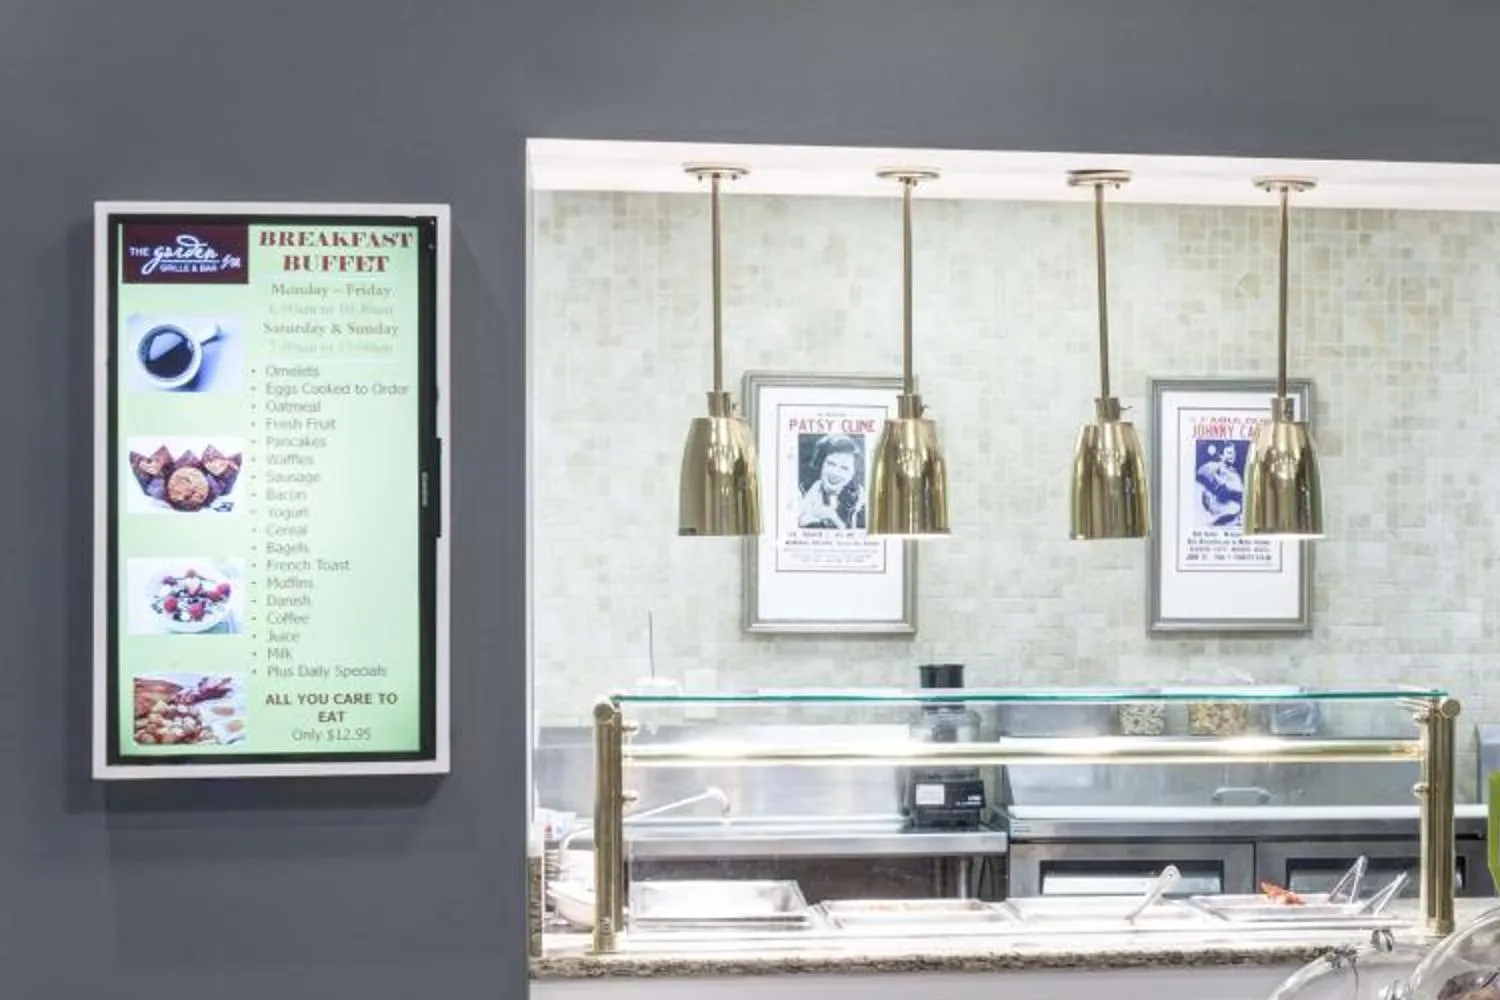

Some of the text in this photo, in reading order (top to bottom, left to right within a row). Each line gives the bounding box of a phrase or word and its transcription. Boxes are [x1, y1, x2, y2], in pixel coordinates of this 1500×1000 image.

[258, 231, 414, 248] BREAKFAST
[129, 247, 151, 257] THE
[200, 264, 218, 273] BAR
[283, 255, 391, 273] BUFFET
[271, 283, 329, 298] Monday
[345, 283, 393, 299] Friday
[262, 322, 400, 337] Saturday & Sunday
[266, 365, 321, 378] Omelets
[266, 382, 410, 397] Eggs Cooked to Order
[266, 400, 322, 414] Oatmeal
[266, 418, 337, 431] Fresh Fruit
[789, 417, 877, 433] PATSY CLINE
[266, 436, 328, 449] Pancakes
[266, 453, 315, 466] Waffles
[266, 471, 322, 485] Sausage
[266, 488, 308, 501] Bacon
[267, 506, 310, 521] Yogurt
[266, 524, 308, 537] Cereal
[266, 541, 310, 556] Bagels
[267, 559, 352, 572] French Toast
[267, 577, 315, 590] Muffins
[267, 595, 312, 607] Danish
[267, 611, 310, 626] Coffee
[267, 629, 301, 643] Juice
[267, 648, 293, 660] Milk
[267, 664, 388, 679] Plus Daily Specials
[265, 693, 399, 706] ALL YOU CARE TO
[318, 711, 346, 724] EAT
[292, 727, 372, 743] Only $12.95
